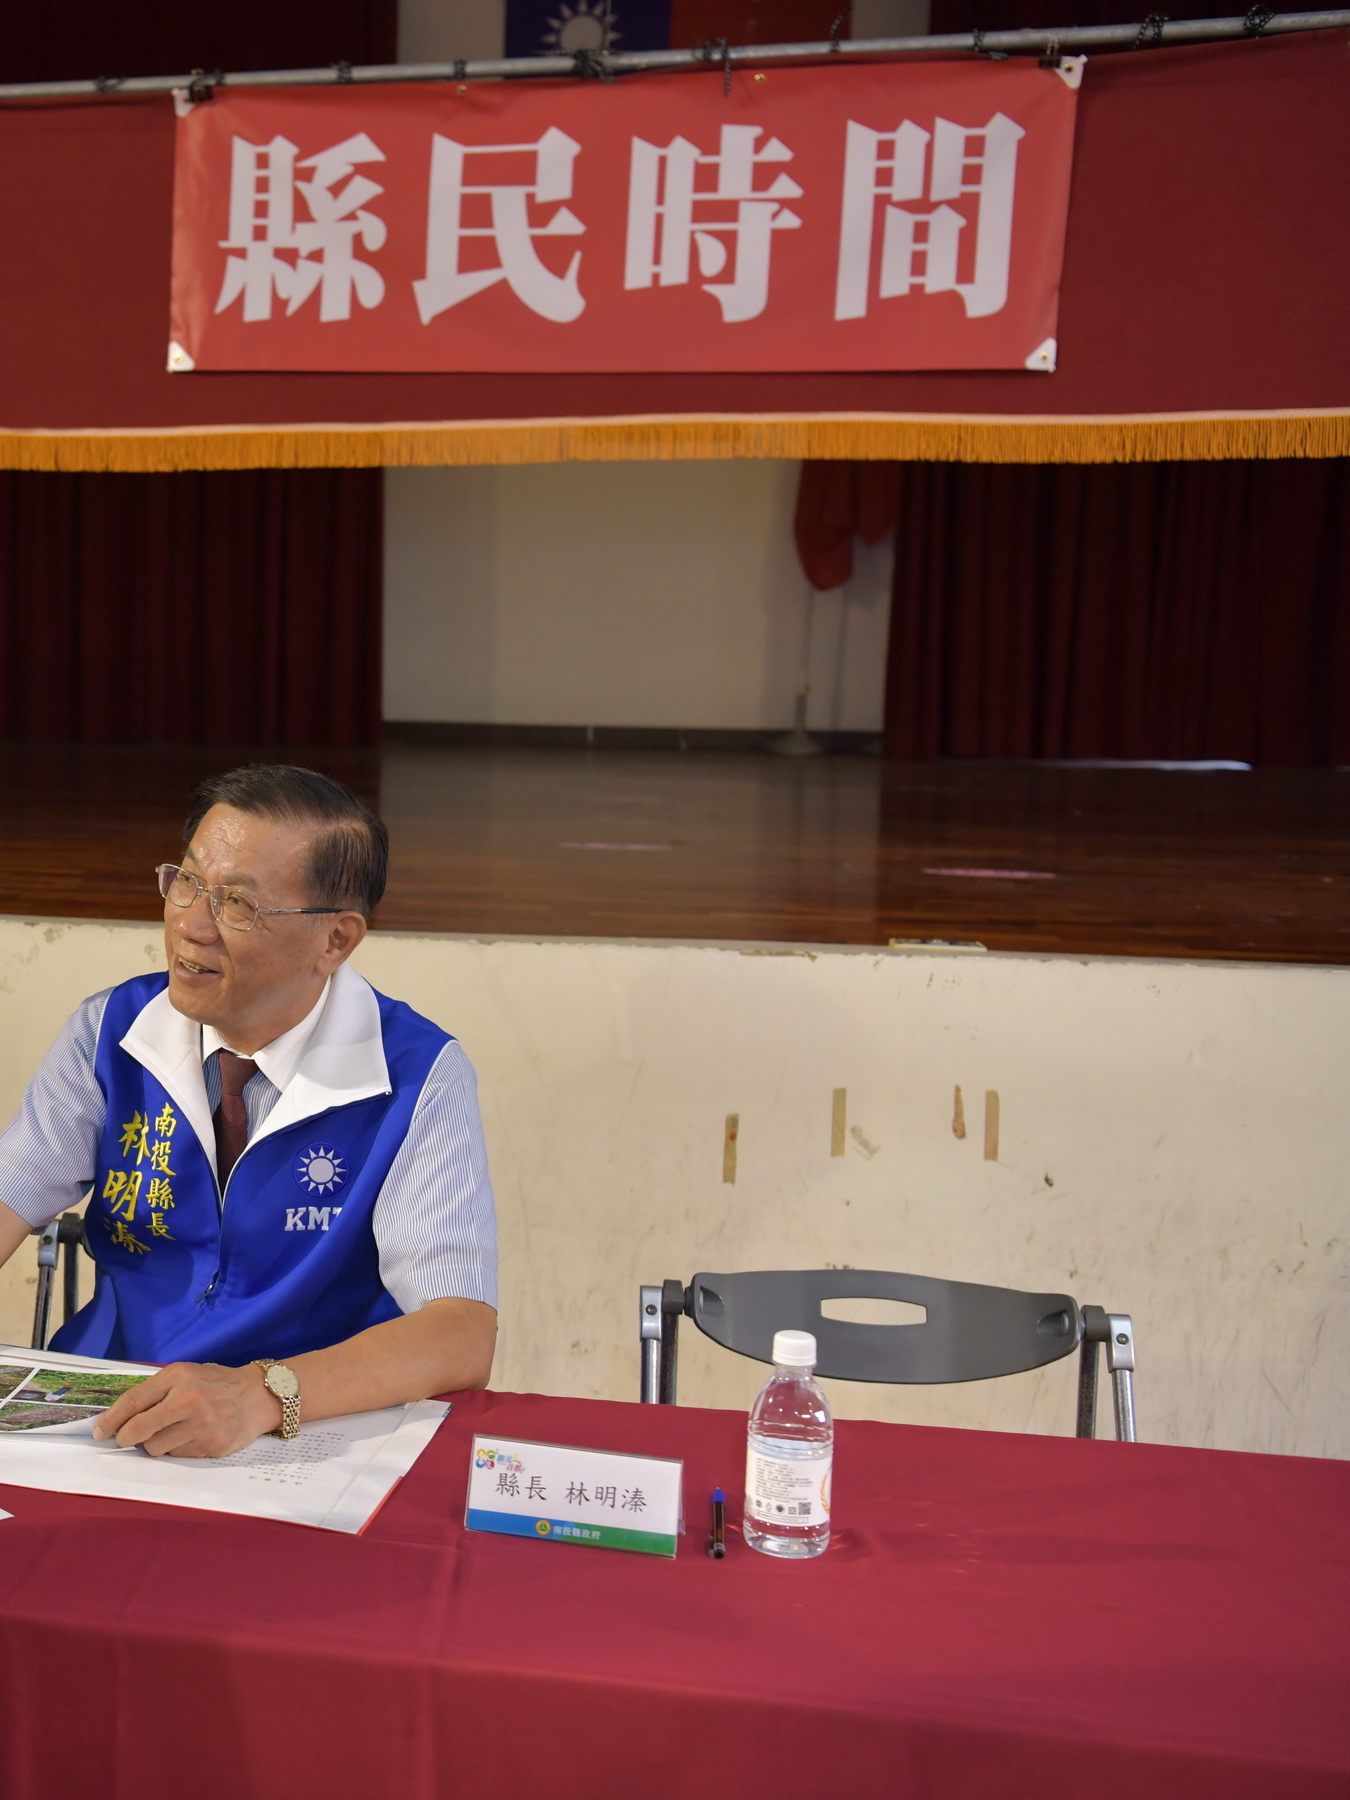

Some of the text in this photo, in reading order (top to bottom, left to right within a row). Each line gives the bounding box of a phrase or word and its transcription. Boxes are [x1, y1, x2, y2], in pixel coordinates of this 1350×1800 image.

[215, 112, 1025, 324] 縣民時間
[145, 1102, 177, 1241] 南投縣長
[495, 1472, 648, 1513] 縣長 林明溱
[552, 1525, 601, 1540] 南投縣政府
